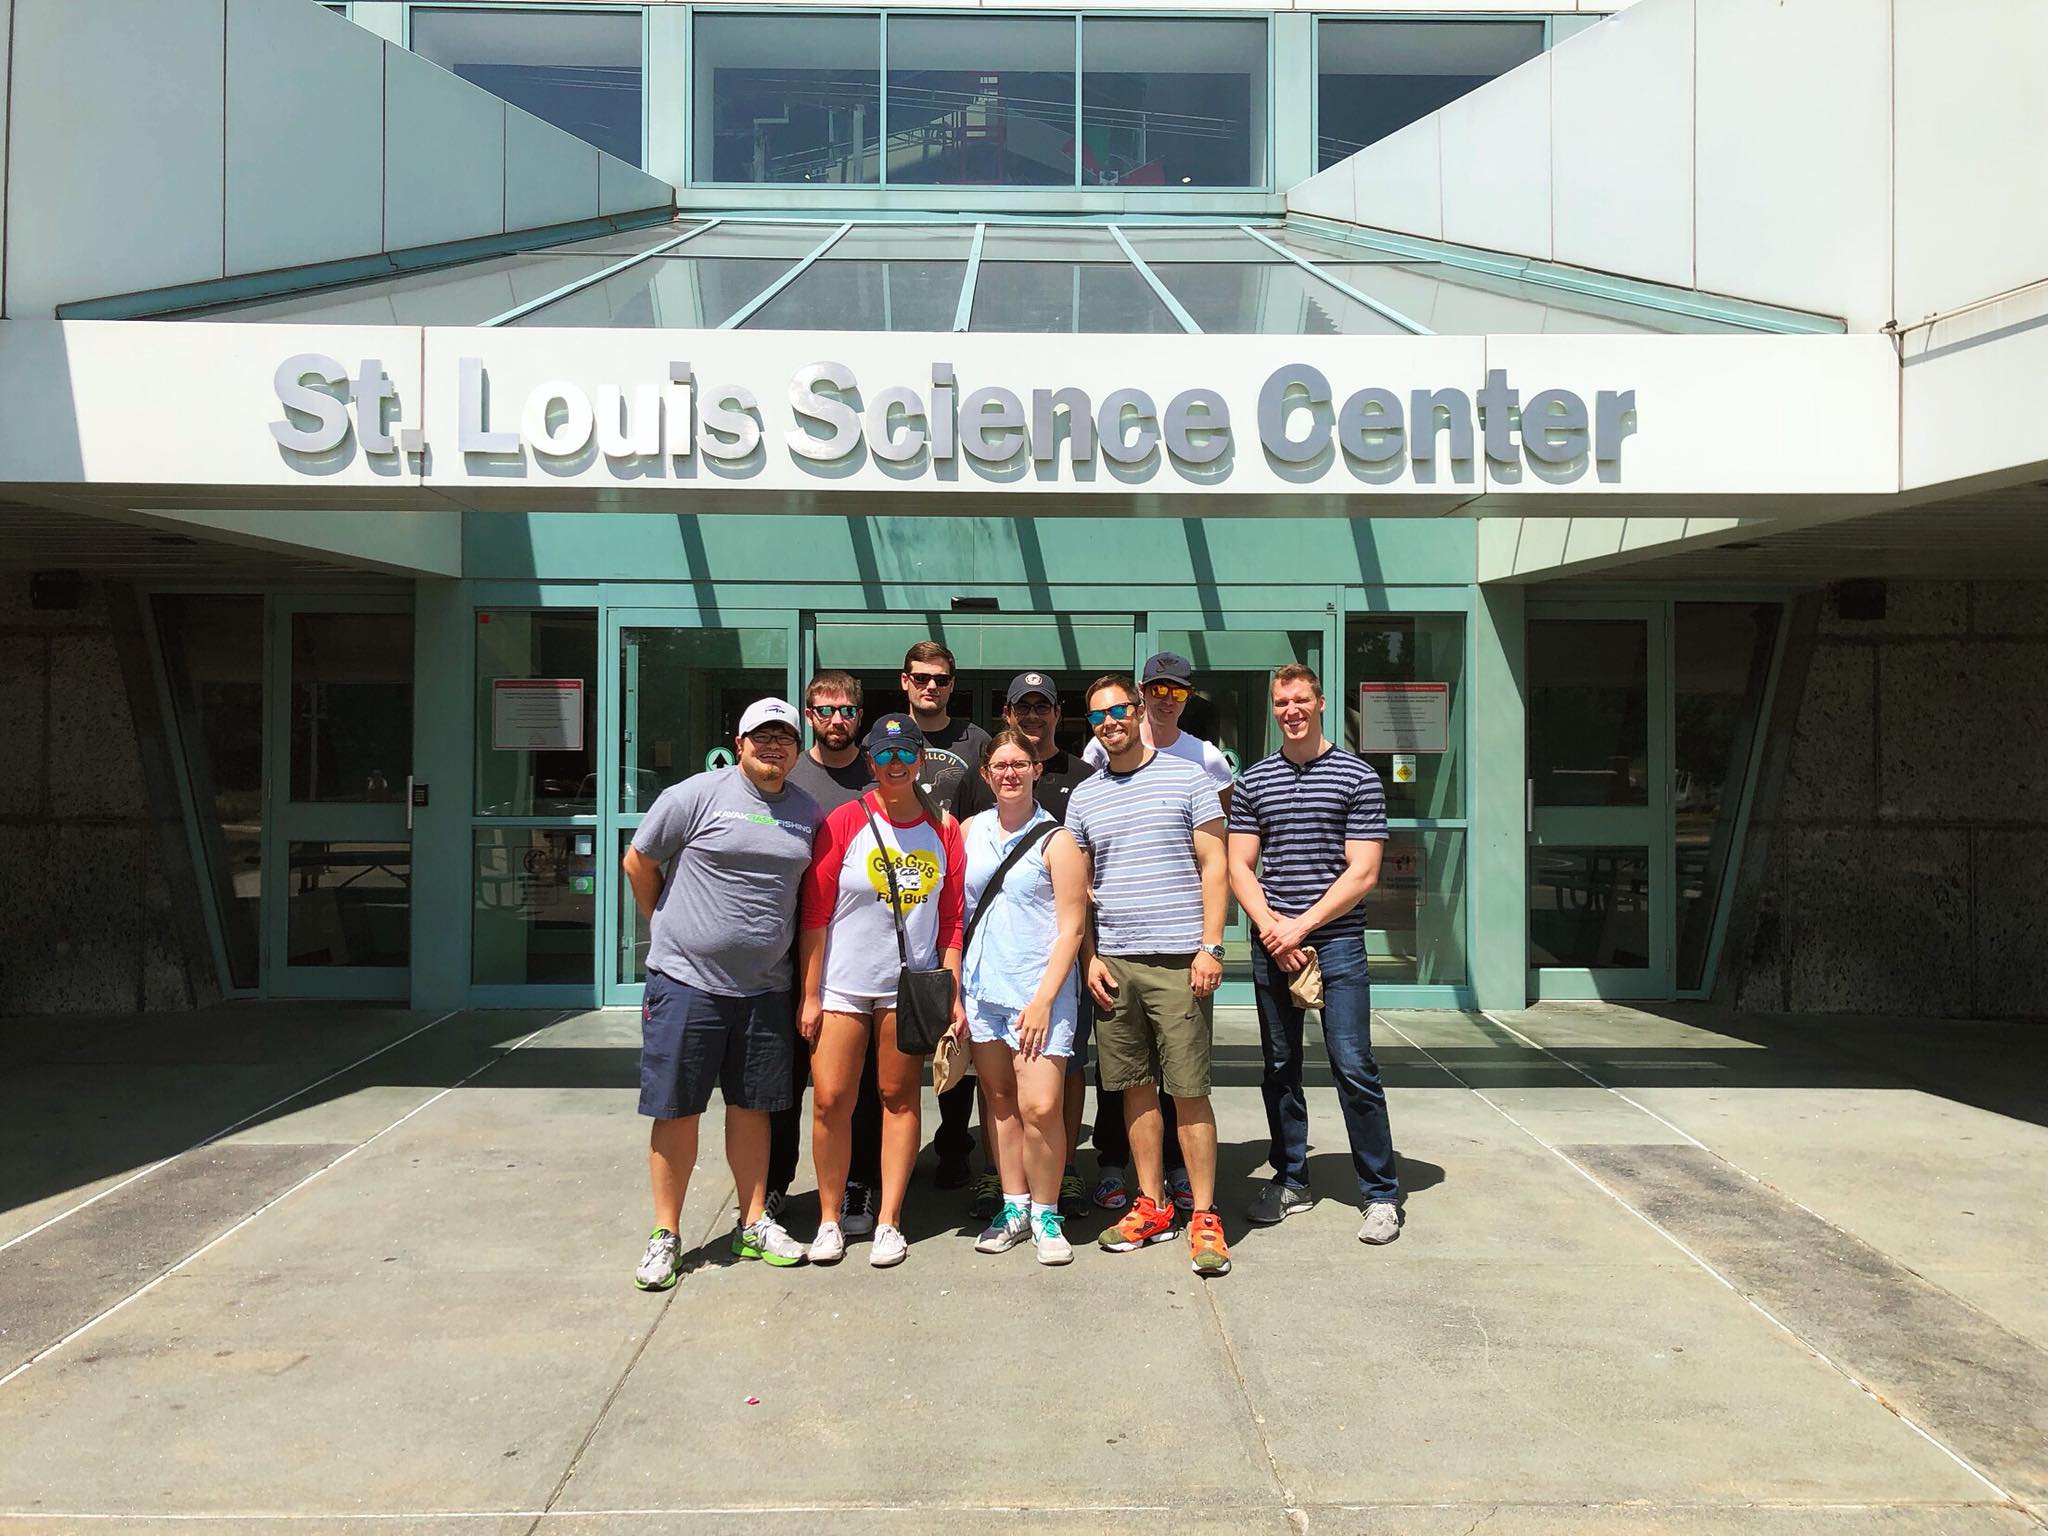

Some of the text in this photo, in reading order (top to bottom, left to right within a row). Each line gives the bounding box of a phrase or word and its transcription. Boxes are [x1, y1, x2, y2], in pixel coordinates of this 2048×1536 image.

[268, 352, 1637, 464] St. Louis Science Center
[876, 891, 929, 904] FU BUS
